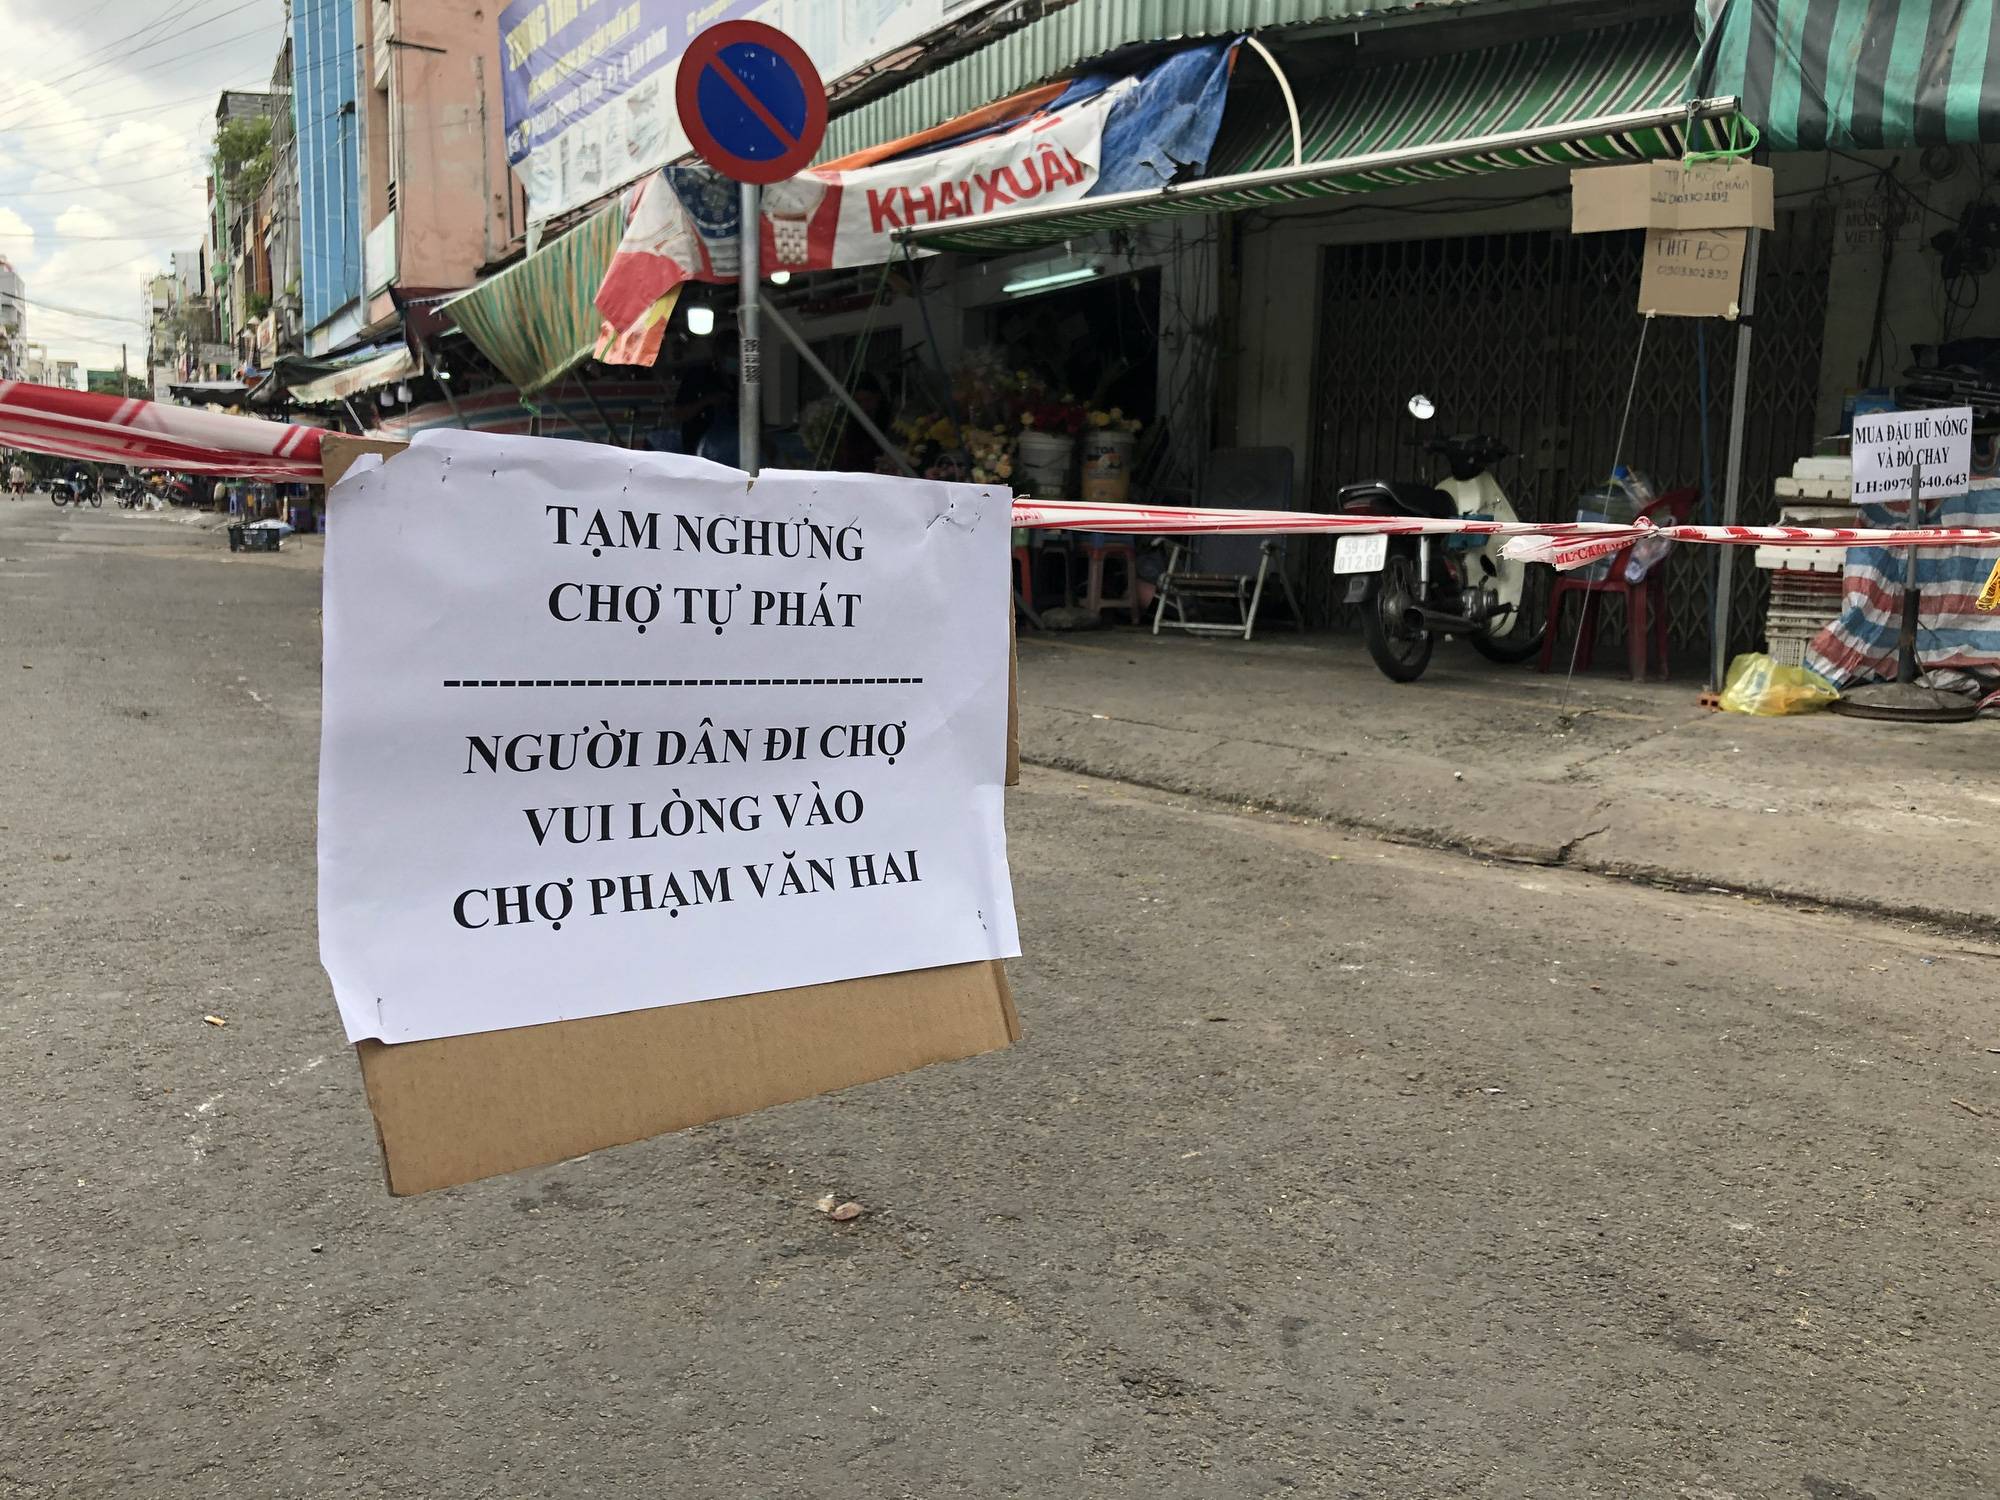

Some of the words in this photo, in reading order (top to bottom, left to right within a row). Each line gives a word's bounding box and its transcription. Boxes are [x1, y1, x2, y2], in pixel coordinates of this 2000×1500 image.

[866, 181, 973, 234] KHAI
[1855, 425, 1883, 445] MUA
[1886, 421, 1912, 445] ĐẬU
[1915, 418, 1932, 439] HŨ
[1934, 415, 1968, 438] NÓNG
[1877, 447, 1894, 469] VÀ
[1916, 446, 1950, 466] CHAY
[546, 506, 661, 557] TẠM
[549, 583, 661, 634] CHỢ
[674, 584, 741, 635] TỰ
[751, 582, 861, 627] PHÁT
[463, 721, 643, 774] NGƯỜI
[654, 718, 752, 766] DÂN
[763, 727, 809, 761] ĐI
[820, 721, 906, 765] CHỢ
[523, 805, 614, 846] VUI
[629, 789, 761, 839] LÒNG
[773, 781, 863, 827] VÀO
[454, 878, 573, 930] CHỢ
[587, 867, 732, 918] PHẠM
[743, 851, 834, 898] VĂN
[846, 851, 920, 888] HAI
